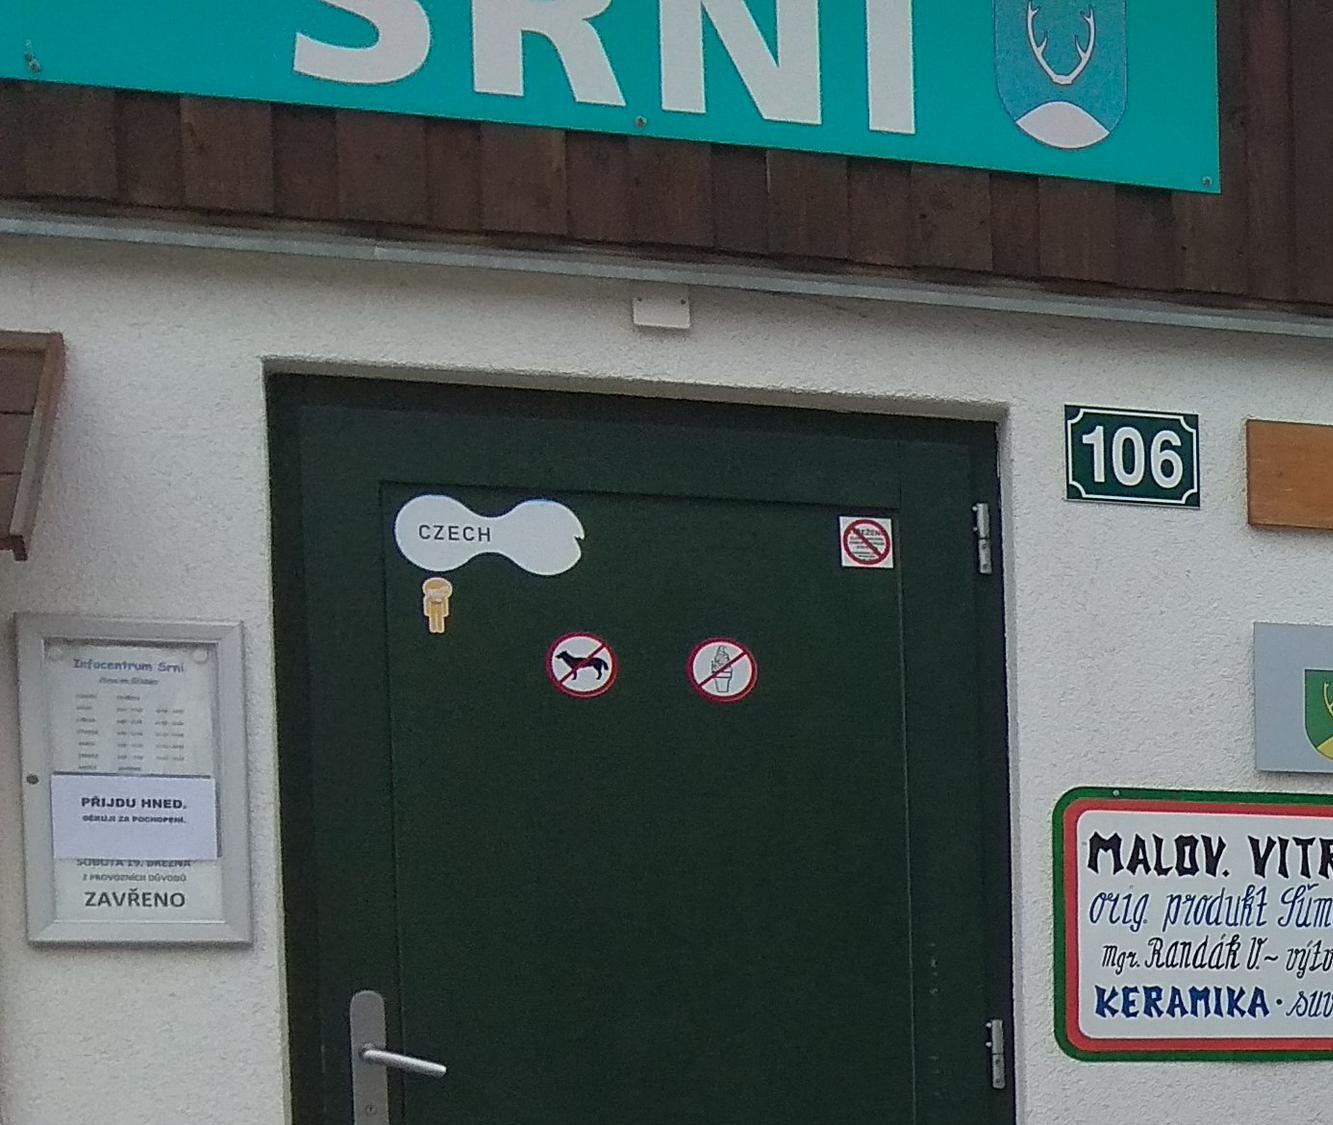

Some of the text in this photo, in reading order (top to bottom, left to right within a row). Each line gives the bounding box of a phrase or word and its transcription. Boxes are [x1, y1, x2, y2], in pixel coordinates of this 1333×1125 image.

[1081, 424, 1184, 489] 106
[418, 523, 492, 543] CZECH
[73, 658, 152, 672] Infocentrum
[81, 796, 187, 809] PŘIJDU HNED.
[1087, 831, 1230, 878] MALOV.
[84, 887, 186, 908] ZAVŘENO
[1089, 884, 1148, 932] orig.
[1163, 884, 1268, 932] produkt
[1094, 984, 1271, 1019] KERAMIKA
